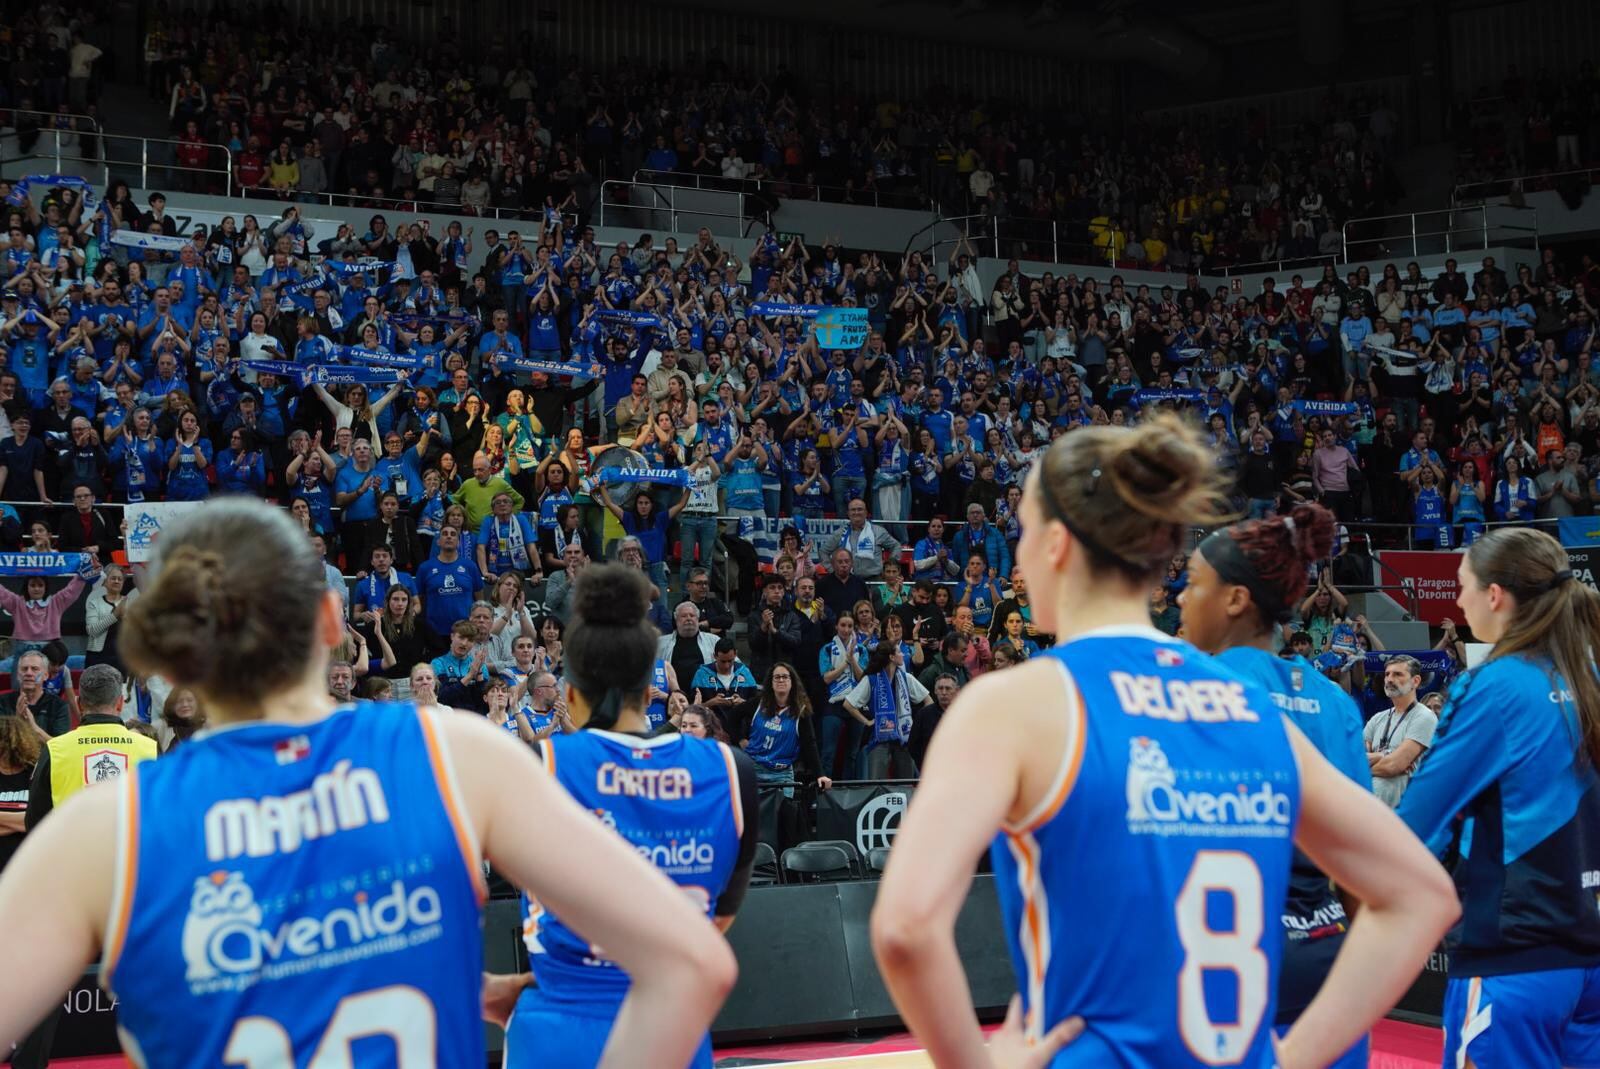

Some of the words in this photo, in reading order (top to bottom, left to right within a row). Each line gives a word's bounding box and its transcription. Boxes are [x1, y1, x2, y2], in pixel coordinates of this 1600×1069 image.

[1305, 401, 1347, 411] AVENIDA
[620, 467, 677, 478] AVENIDA
[1417, 577, 1456, 590] Zaragoza
[77, 736, 133, 745] SEGURIDAD
[596, 761, 693, 801] CARTER
[886, 797, 903, 805] FEB
[637, 837, 714, 866] enida
[1175, 849, 1269, 1066] 8
